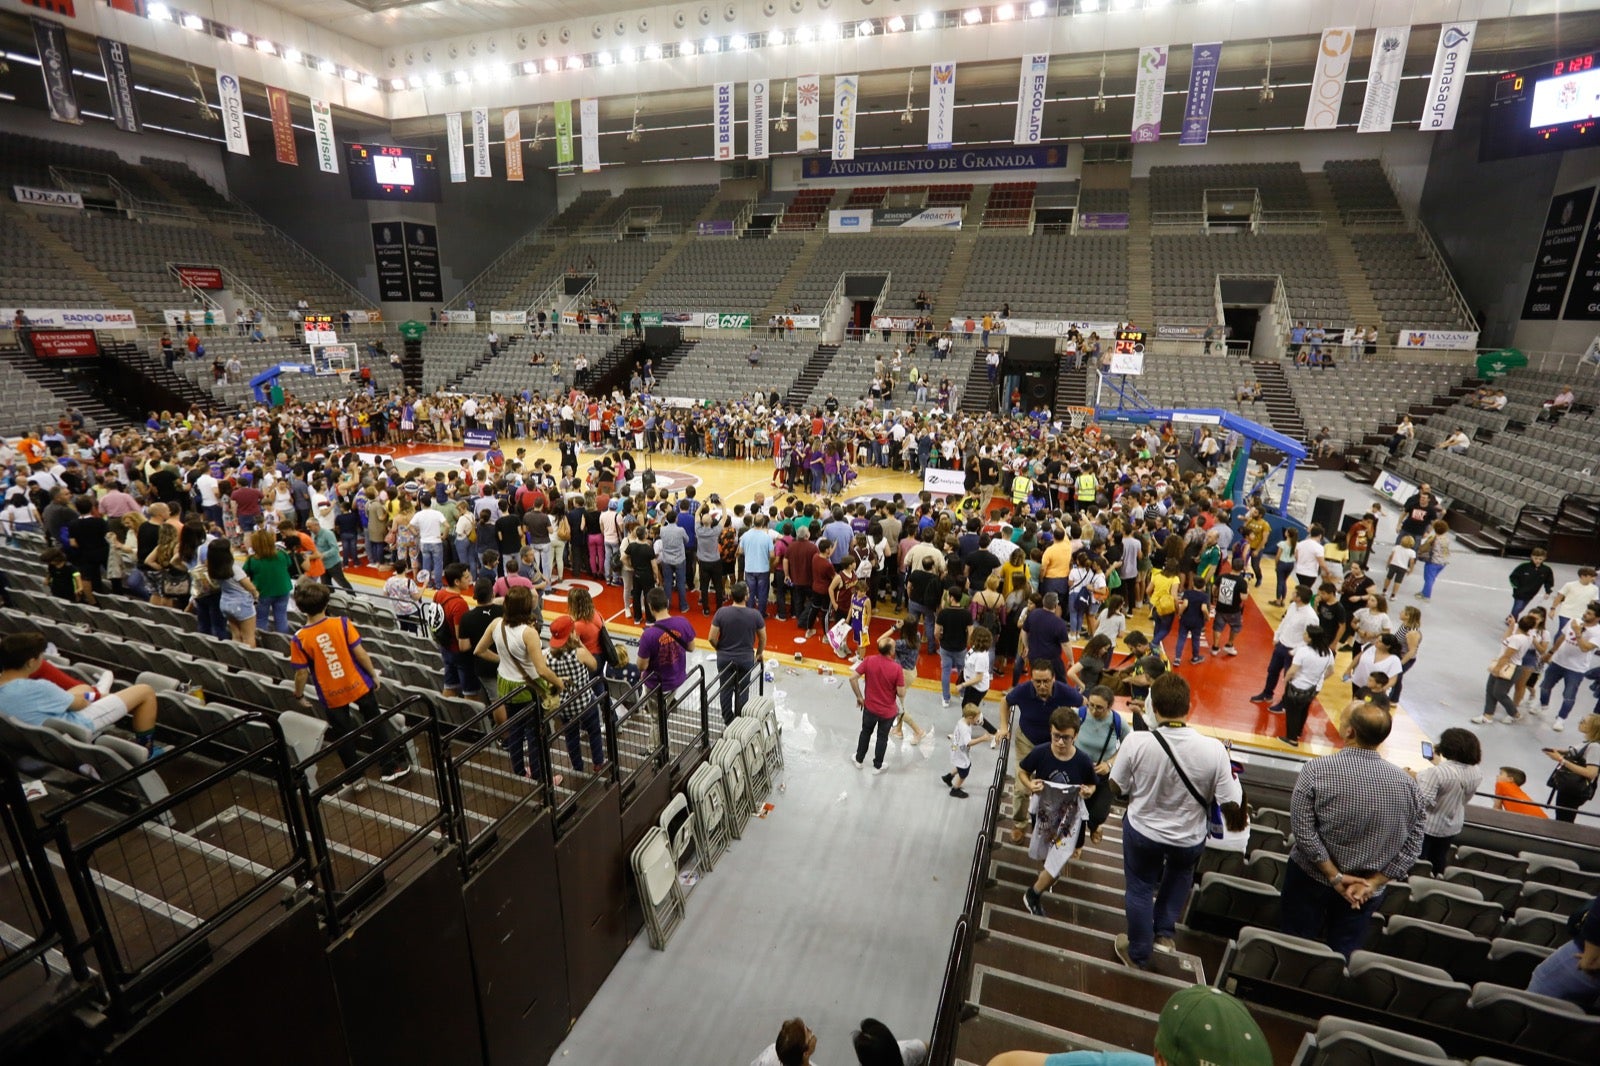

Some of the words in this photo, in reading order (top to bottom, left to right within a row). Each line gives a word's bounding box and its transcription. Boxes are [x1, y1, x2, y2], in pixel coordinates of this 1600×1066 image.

[1145, 79, 1156, 110] Palacio
[1198, 70, 1211, 115] MOTRIL
[1431, 51, 1458, 128] emasagra
[1513, 76, 1523, 91] 0
[718, 85, 730, 143] BERNER
[1029, 74, 1045, 142] ESCOLANO
[1135, 79, 1147, 120] Deportes
[228, 96, 243, 139] Cuerva
[318, 118, 333, 171] fertisac
[477, 125, 487, 176] emasagra
[828, 156, 935, 175] AYUNTAMIENTO
[937, 157, 958, 170] DE
[962, 151, 1036, 169] GRANADA
[20, 188, 79, 205] IDEAL
[62, 313, 95, 322] RADIO
[720, 314, 749, 328] CSIF
[35, 332, 91, 341] AYUNTAMIENTO
[53, 339, 89, 347] GRANADA
[1116, 340, 1134, 354] 24
[1427, 333, 1469, 341] MANZANO
[315, 632, 345, 679] GMASB
